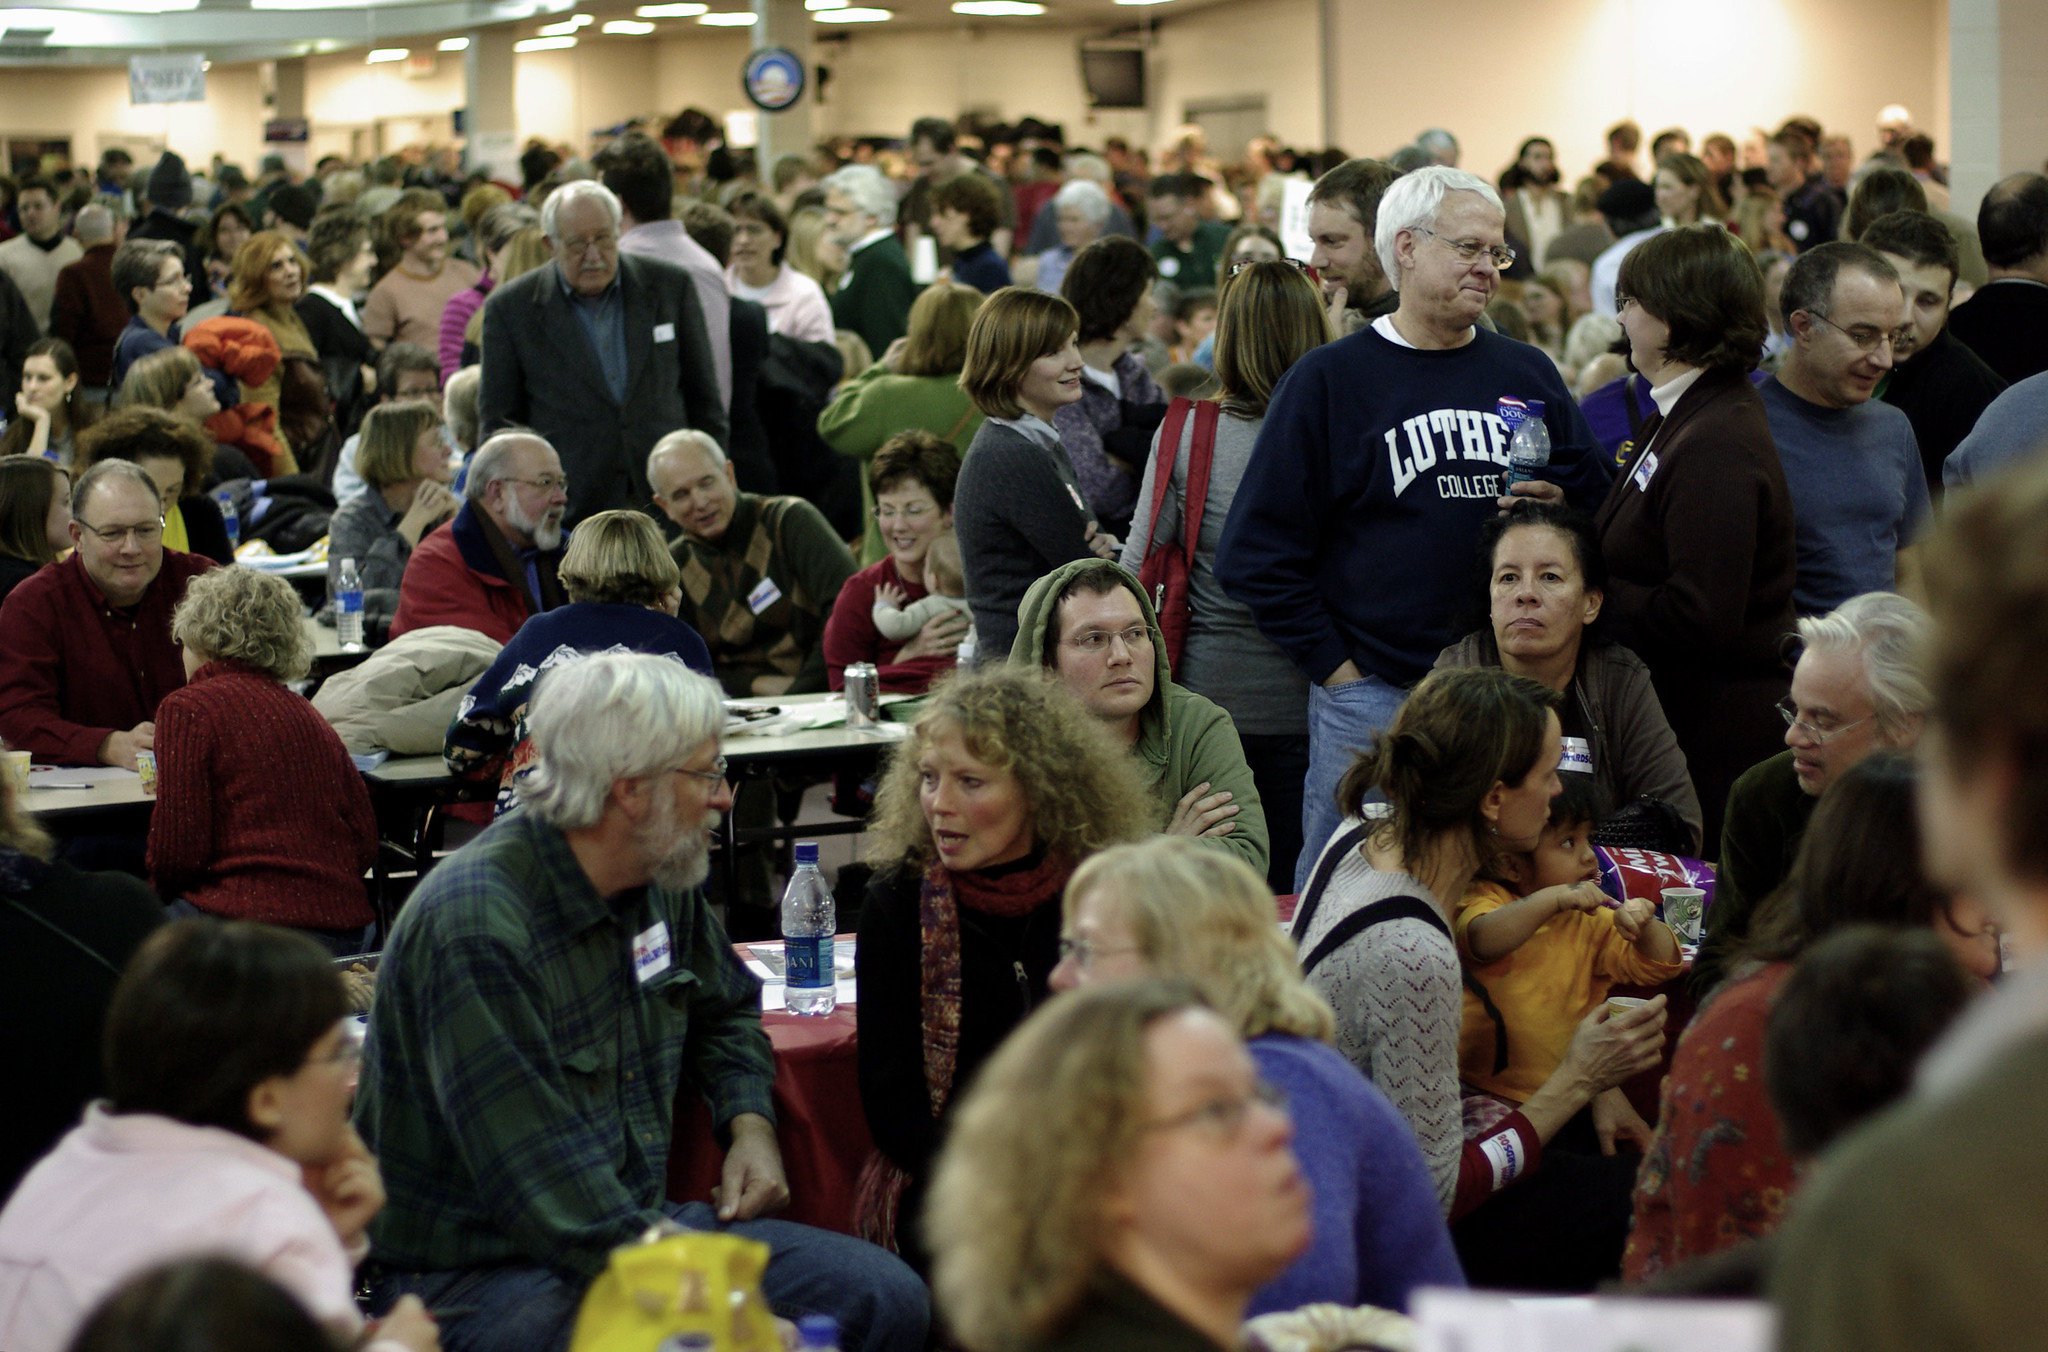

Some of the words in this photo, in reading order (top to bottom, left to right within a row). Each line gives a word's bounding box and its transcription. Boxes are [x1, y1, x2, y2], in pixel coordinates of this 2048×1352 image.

[1499, 407, 1524, 420] DOD
[1384, 408, 1510, 498] LUTHE
[1437, 475, 1502, 499] COLLEGE
